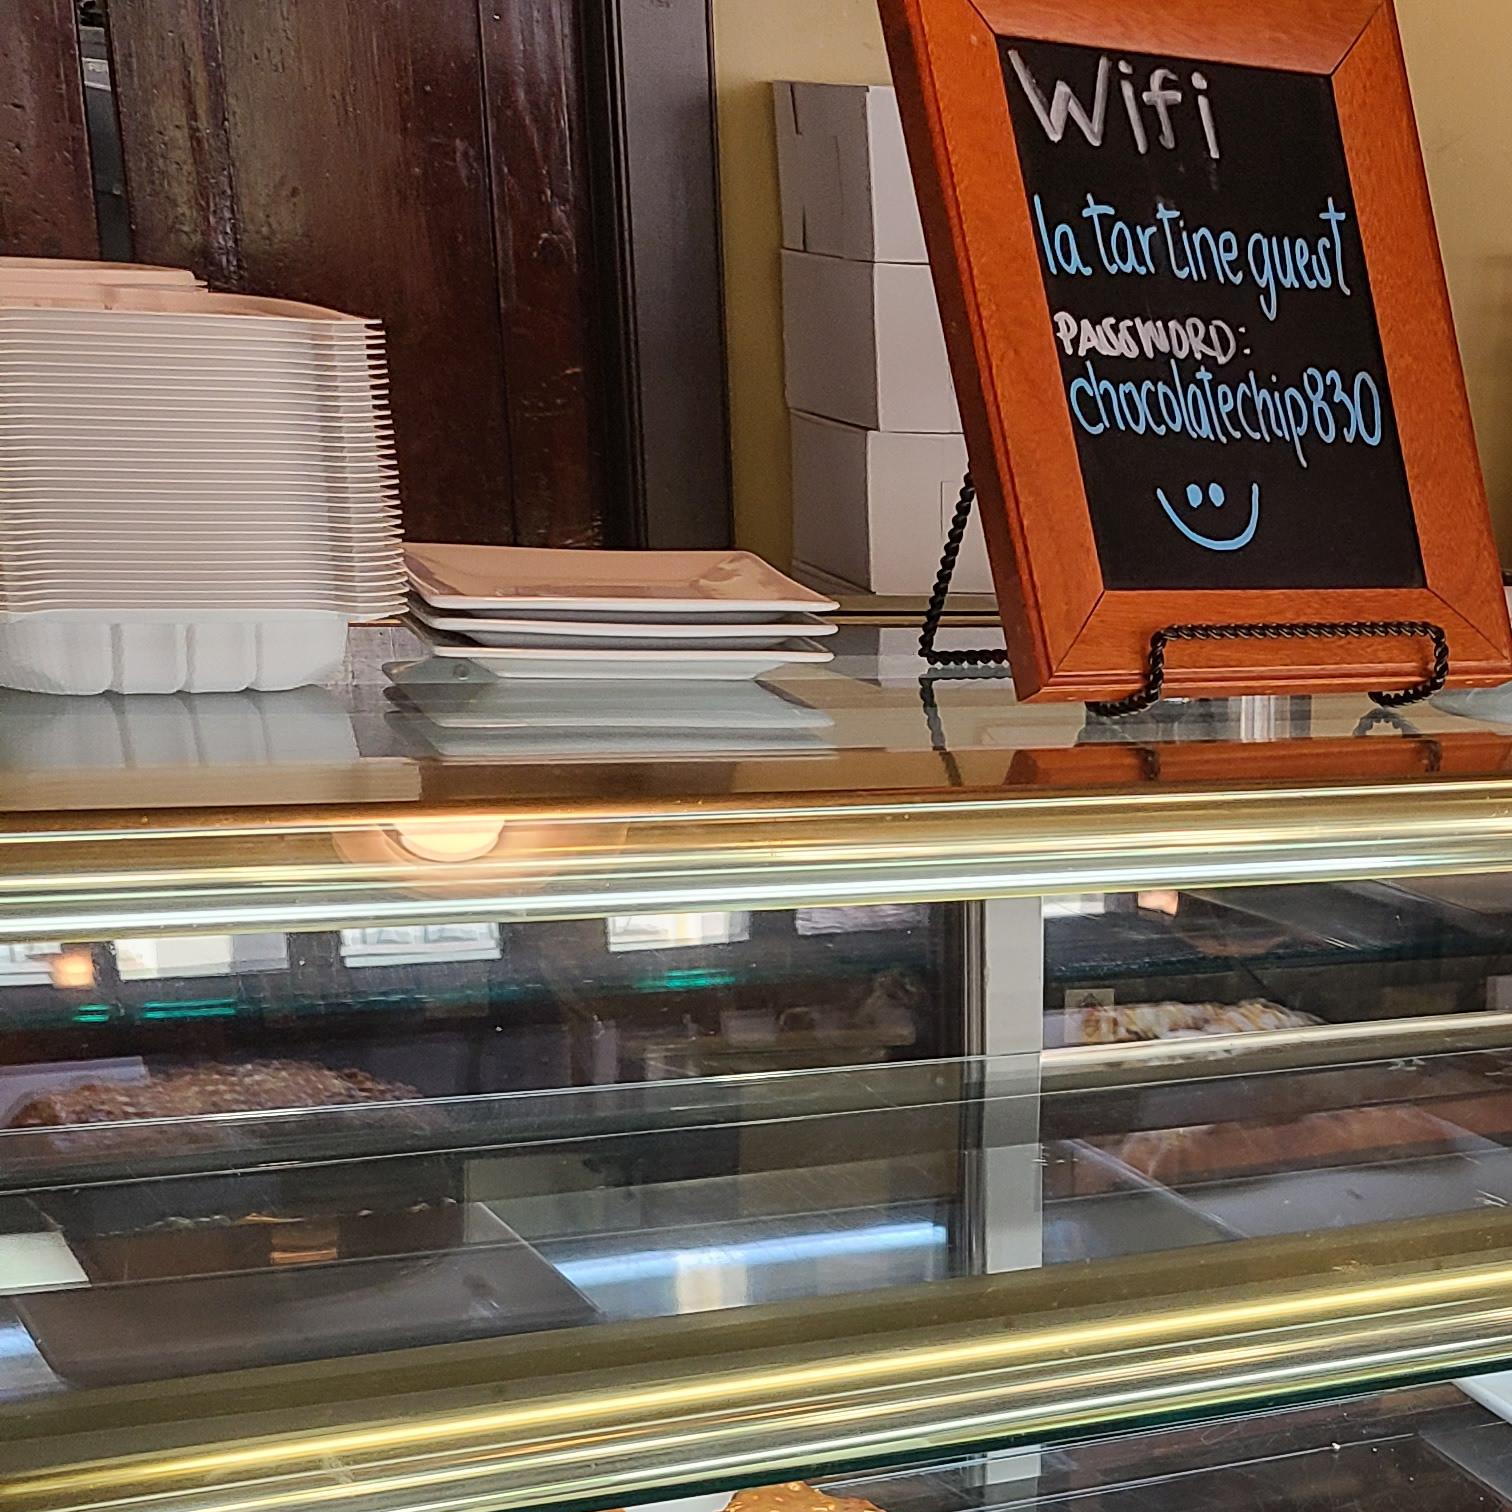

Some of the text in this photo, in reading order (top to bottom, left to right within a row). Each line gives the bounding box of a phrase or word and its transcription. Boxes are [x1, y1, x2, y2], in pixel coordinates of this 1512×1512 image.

[1008, 49, 1220, 159] Wifi
[1033, 194, 1091, 277] la
[1248, 197, 1351, 321] guest
[1054, 311, 1251, 364] PASSWORD:
[1069, 359, 1382, 468] chocolatechip830
